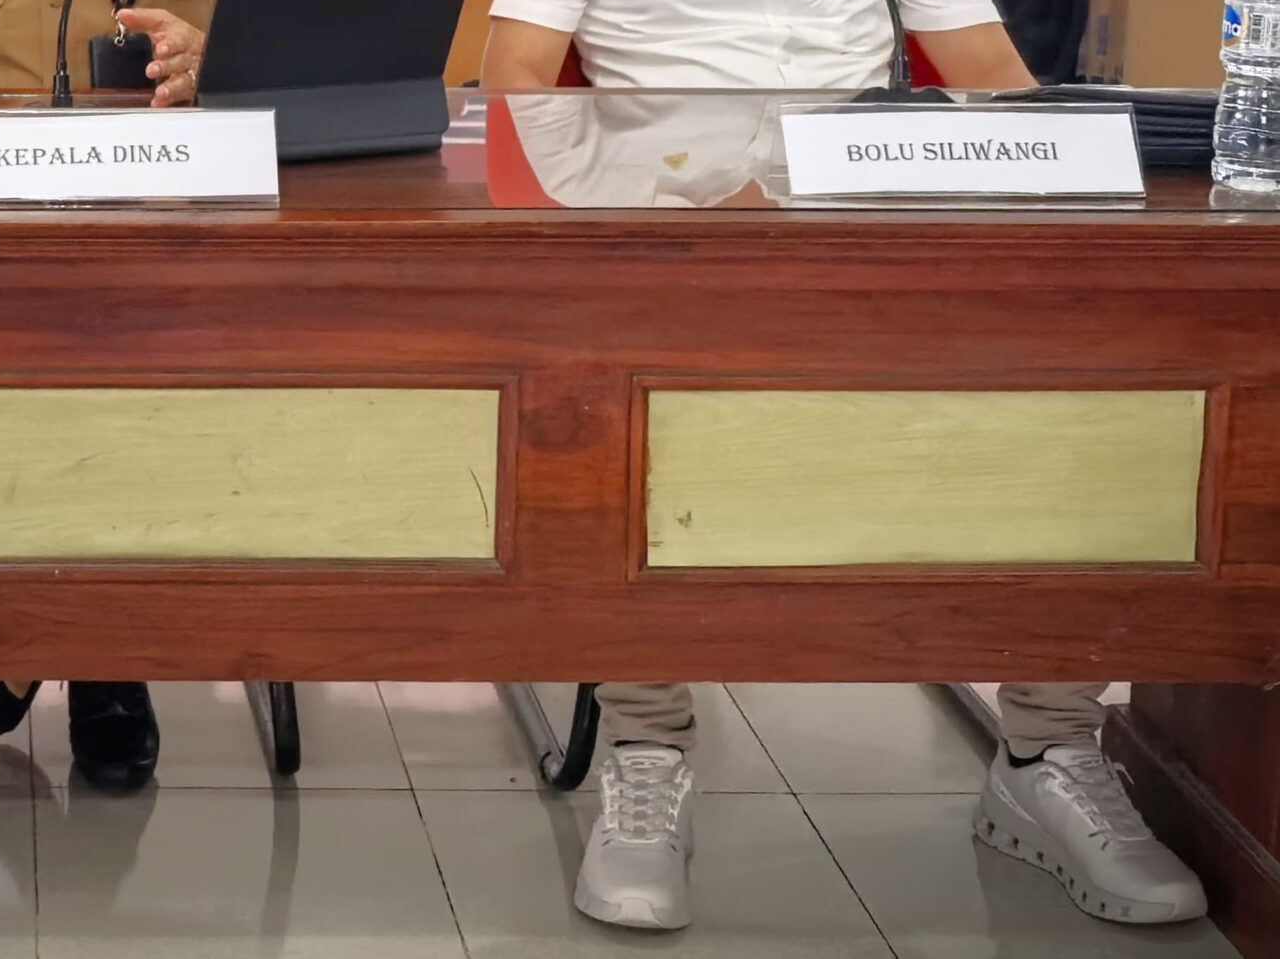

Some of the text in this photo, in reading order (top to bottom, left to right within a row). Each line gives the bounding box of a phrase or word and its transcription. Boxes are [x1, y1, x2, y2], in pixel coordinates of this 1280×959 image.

[112, 144, 191, 164] DINAS
[846, 139, 1060, 162] BOLU SILIWANGI
